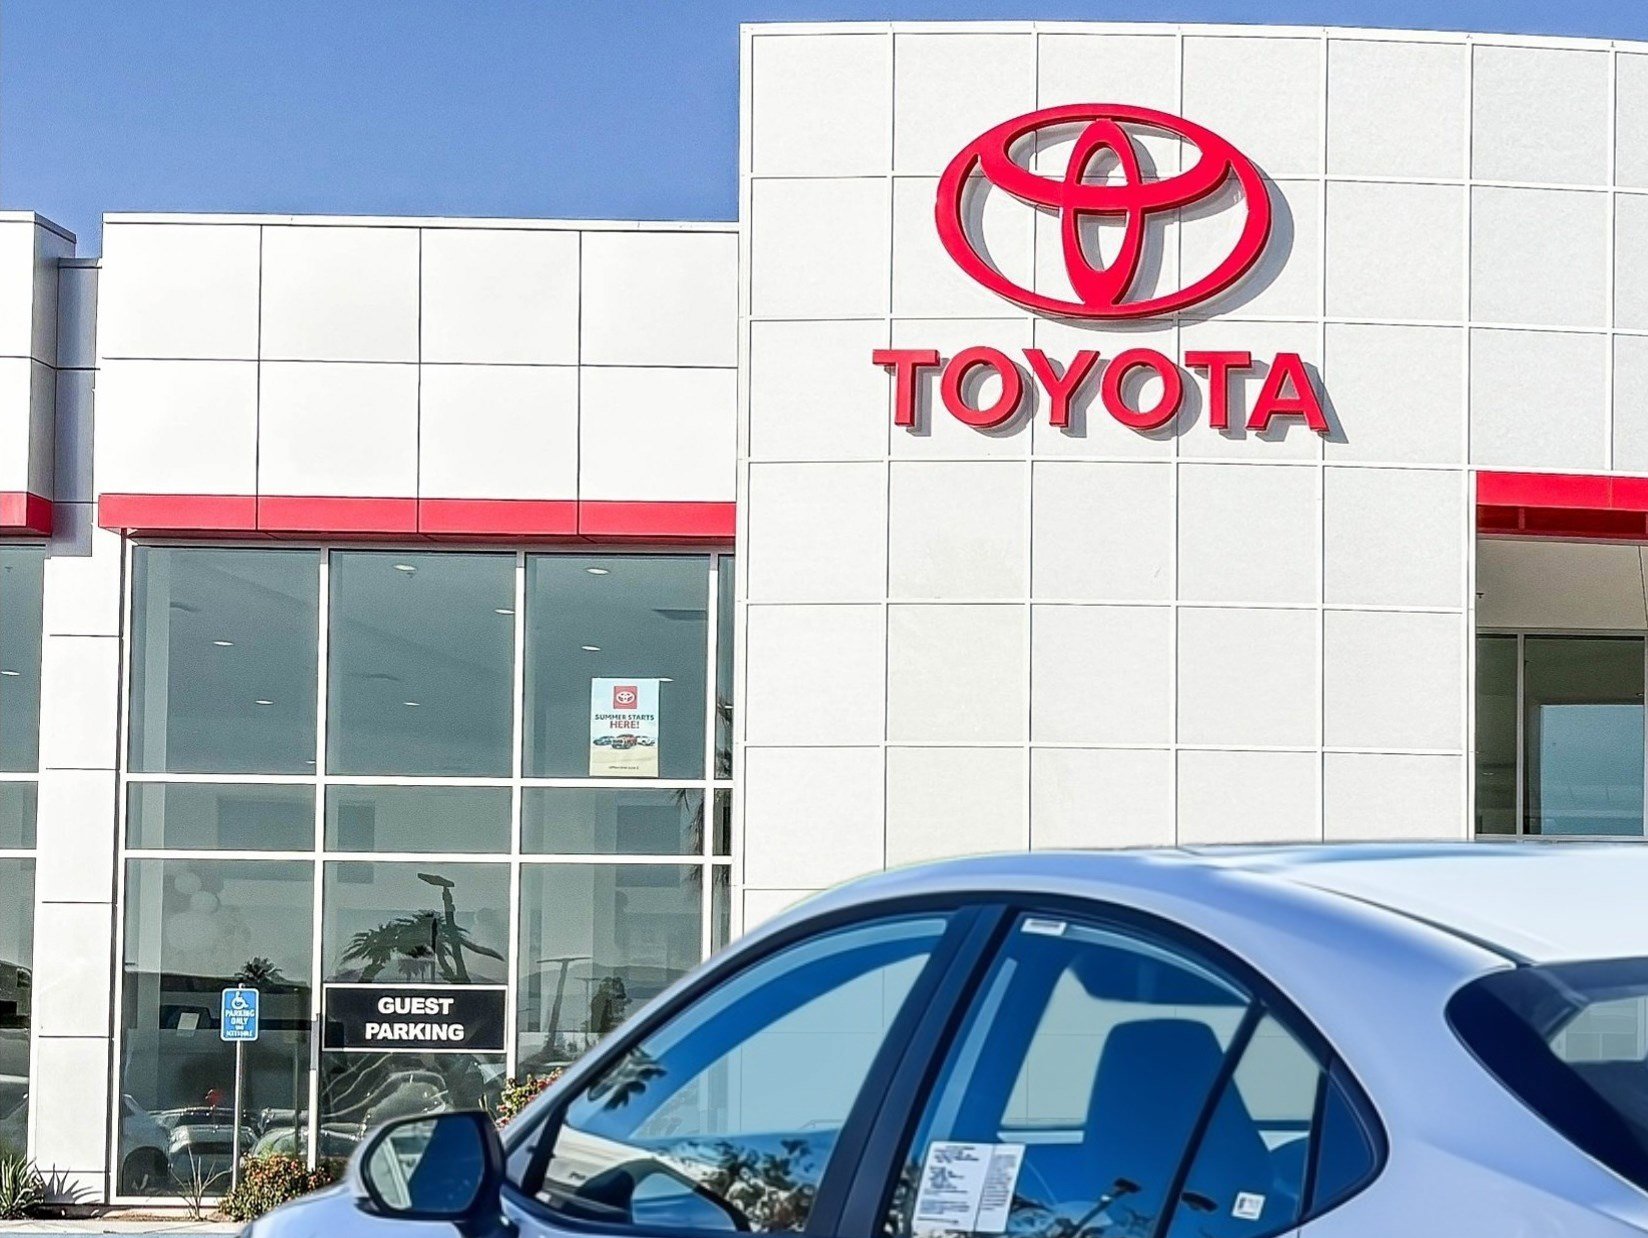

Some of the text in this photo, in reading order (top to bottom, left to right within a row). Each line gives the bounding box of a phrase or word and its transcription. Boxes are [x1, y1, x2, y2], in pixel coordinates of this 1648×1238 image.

[873, 346, 1329, 432] TOYOTA
[595, 713, 627, 721] SUMMER
[610, 720, 640, 729] HERE!
[377, 996, 455, 1015] GUEST
[365, 1022, 465, 1041] PARKING
